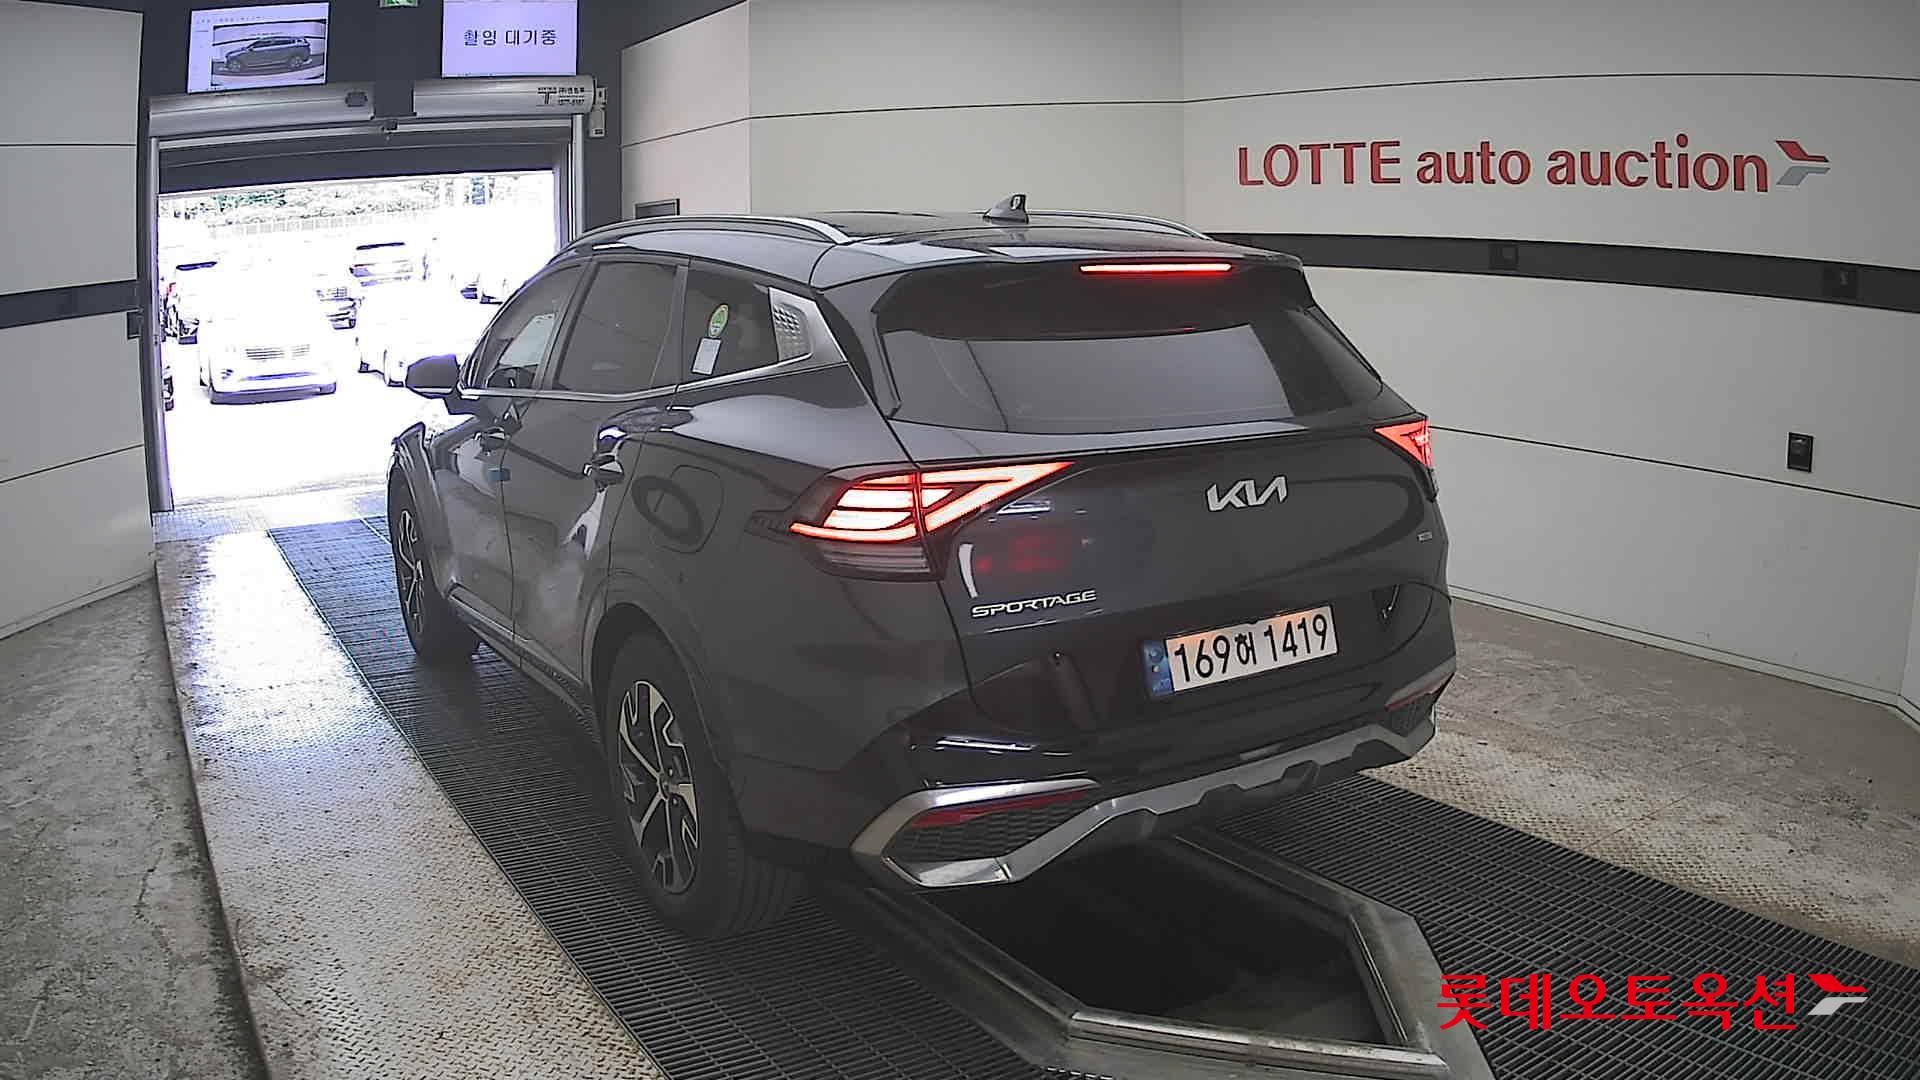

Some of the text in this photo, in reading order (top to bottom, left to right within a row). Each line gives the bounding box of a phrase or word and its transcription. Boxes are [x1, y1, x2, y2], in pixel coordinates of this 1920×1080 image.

[505, 29, 557, 46] 대기중
[1238, 133, 1768, 193] LOTTE auto auction
[1206, 475, 1288, 512] KIA
[971, 589, 1097, 618] SPORTAGE
[1174, 613, 1328, 683] 169허 1419
